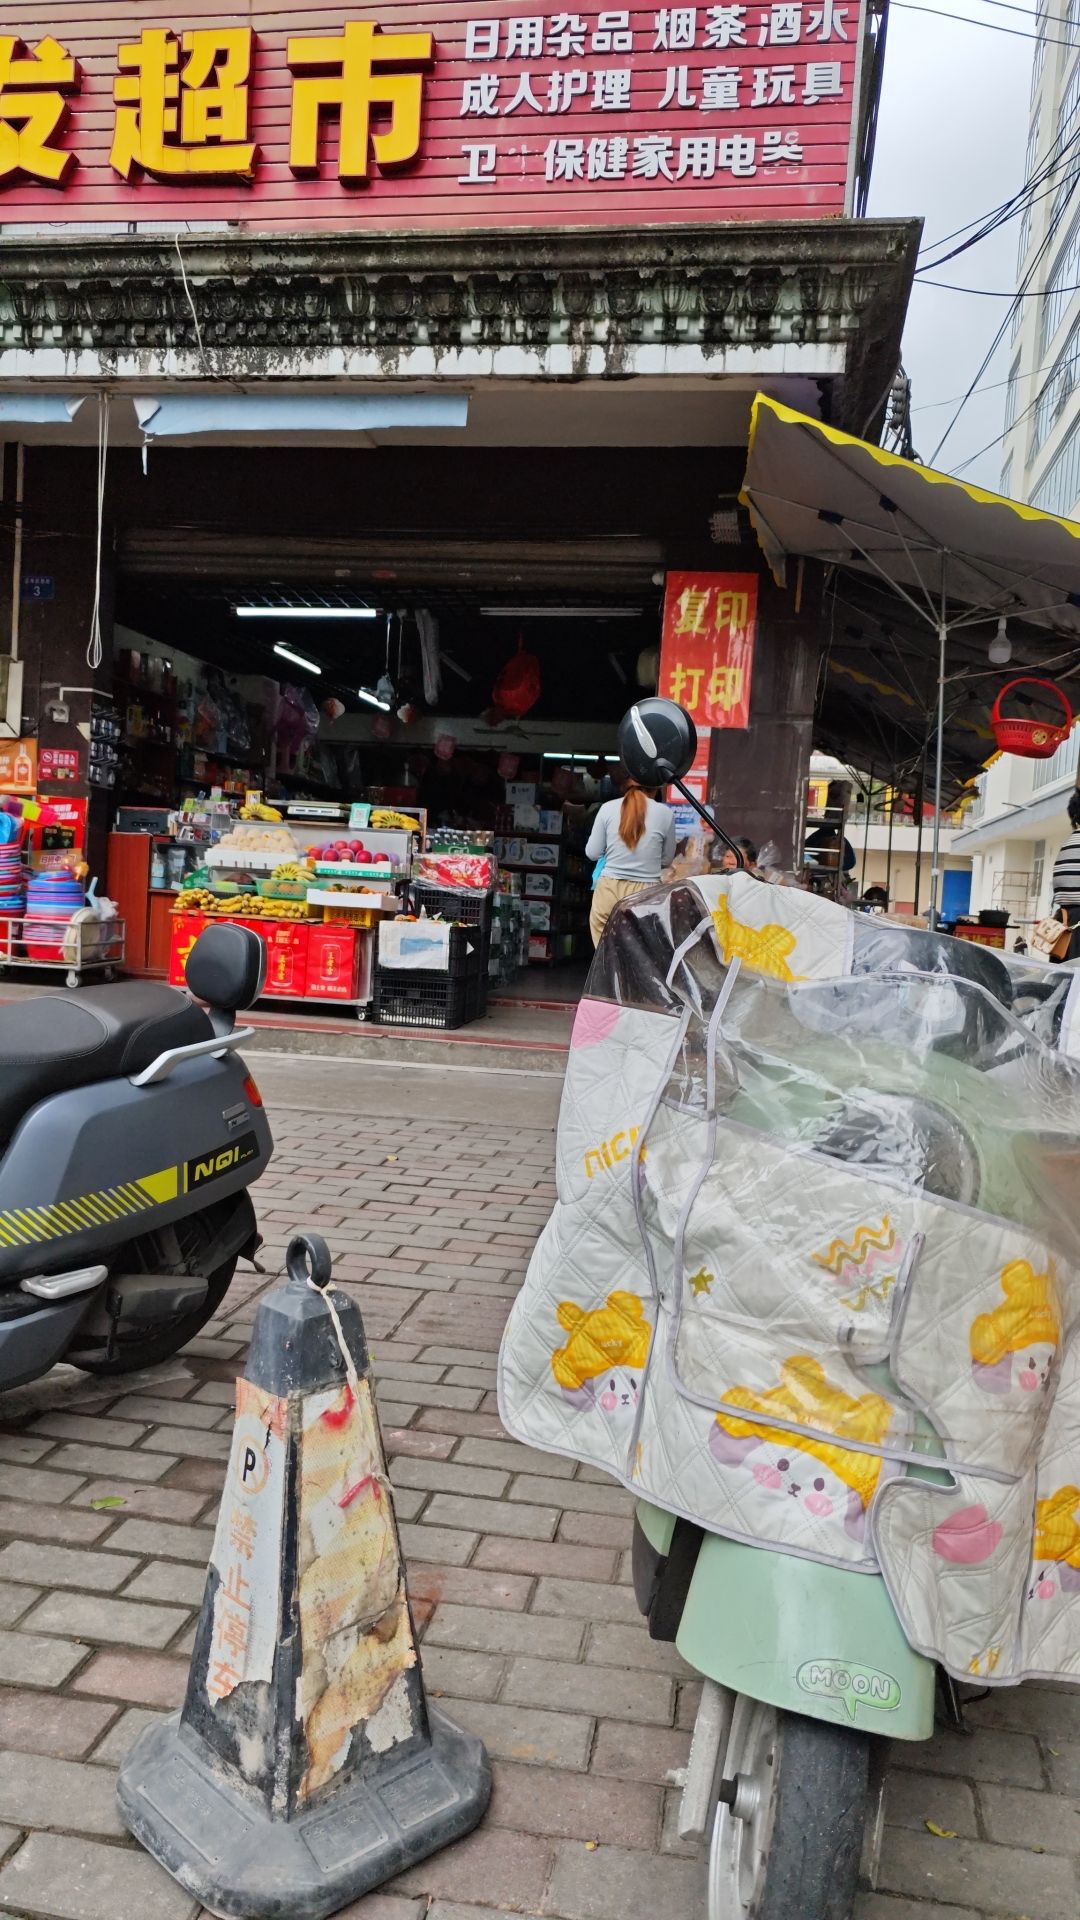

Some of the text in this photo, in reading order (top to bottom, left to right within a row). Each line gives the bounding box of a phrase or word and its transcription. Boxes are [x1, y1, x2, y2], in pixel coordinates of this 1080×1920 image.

[464, 0, 849, 61] 日用杂品 烟茶酒水
[0, 20, 434, 188] 发超市
[460, 62, 843, 118] 成人护理 儿童玩具
[33, 585, 41, 597] 3
[675, 588, 748, 634] 复印
[669, 662, 744, 711] 打印
[810, 1665, 891, 1701] MOON
